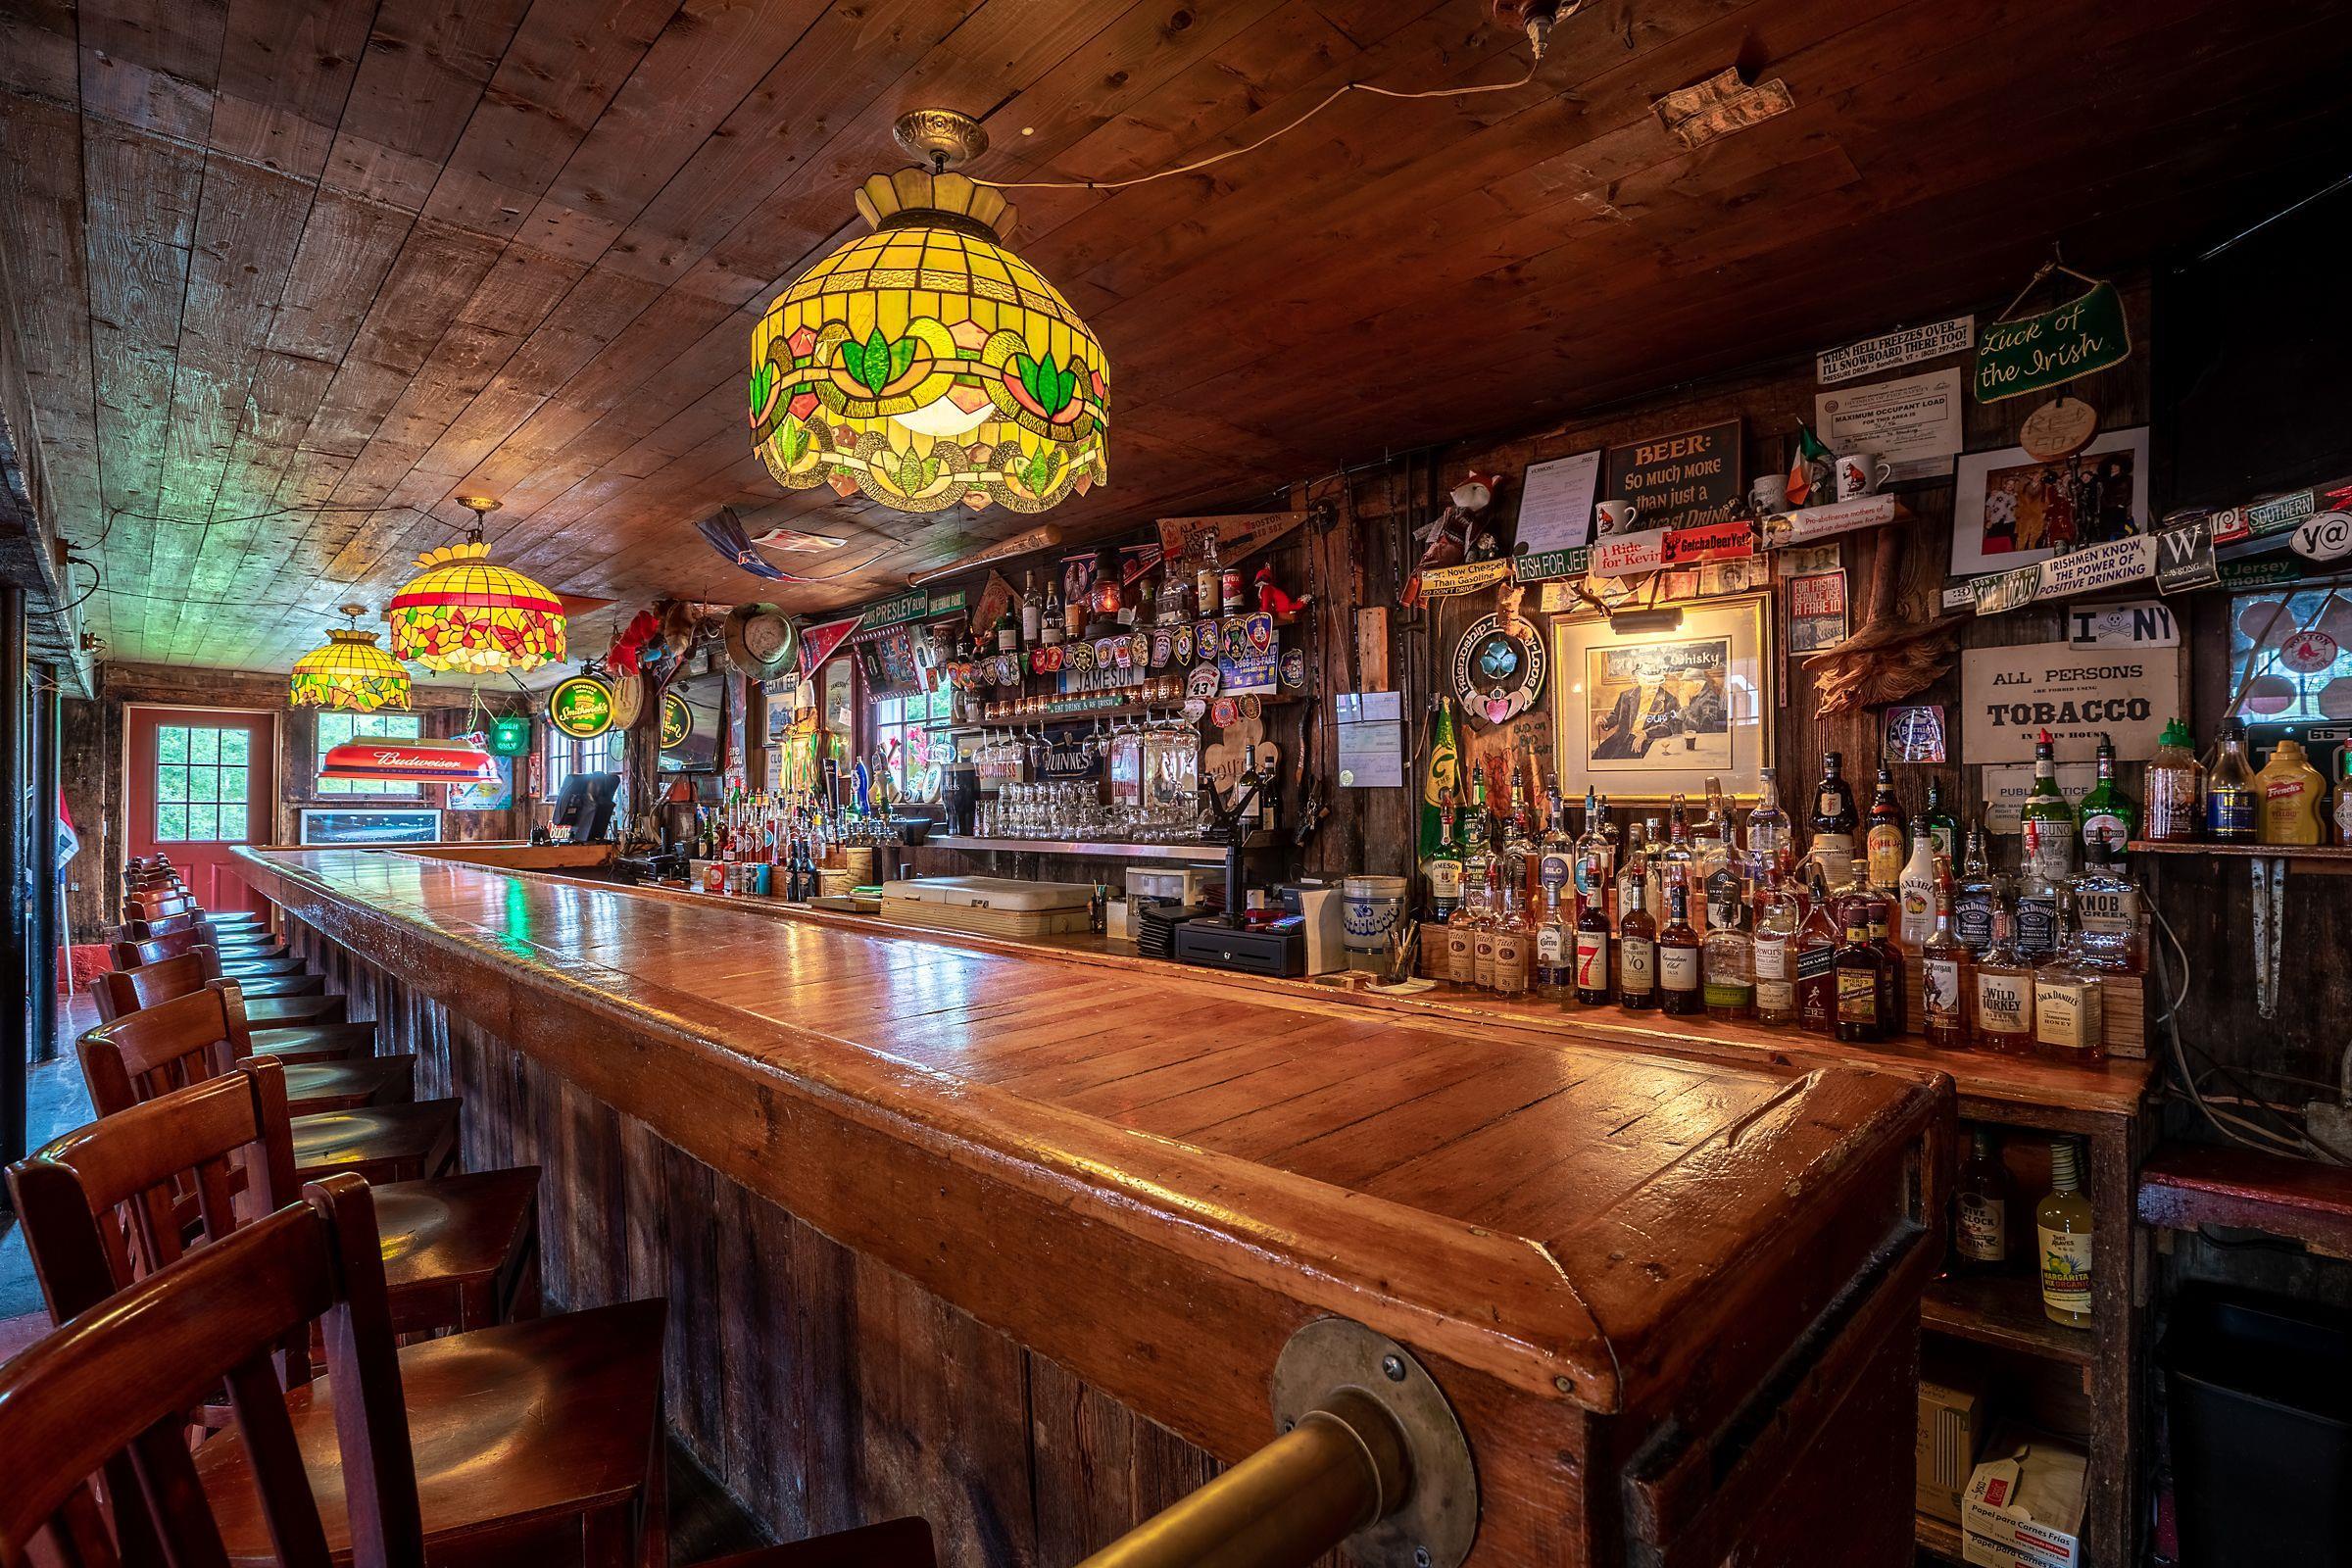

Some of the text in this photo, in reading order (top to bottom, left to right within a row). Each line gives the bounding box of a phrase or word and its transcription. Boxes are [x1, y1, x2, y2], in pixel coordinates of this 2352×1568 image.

[1981, 304, 2085, 356] Luck of
[1823, 329, 1923, 364] WHEN HELL FREEZES
[1823, 329, 1967, 375] I'LL SNOWBOARD THERE TOO!
[1823, 370, 1851, 382] PRESSURE
[1852, 366, 1870, 375] DROP
[1921, 348, 1937, 359] (802)
[1980, 331, 2104, 388] the Irish
[1835, 398, 1945, 423] MAXIMUM OCCUPANT LOAD
[1635, 434, 1712, 466] BEER:
[1531, 465, 1554, 474] VERMONT
[1850, 507, 1875, 518] mothers
[1876, 505, 1884, 514] of
[2250, 497, 2312, 526] SOUTHERN
[1251, 514, 1282, 529] BOSTON
[1269, 524, 1284, 535] SOX
[1612, 541, 1642, 556] Ride
[2163, 524, 2202, 564] W
[1602, 551, 1661, 568] for Kevin
[2049, 540, 2141, 572] IRISHMEN KNOW
[1447, 566, 1467, 577] Now
[1469, 560, 1506, 575] Cheaper
[1520, 552, 1565, 577] FISH FOR
[2056, 554, 2134, 581] THE POWER OF
[2234, 560, 2289, 575] Jersey
[1433, 571, 1494, 588] Than Gasoline
[1794, 577, 1840, 593] FOR FASTER
[1974, 567, 2036, 587] DON'T PISS OFF
[2039, 578, 2084, 596] POSITIVE
[2087, 564, 2145, 586] DRINKING
[2215, 572, 2275, 588] ermont
[1433, 587, 1455, 596] DON'T
[1794, 589, 1840, 604] SERVICE USE
[1978, 584, 1997, 612] THE
[2002, 576, 2036, 610] LOCALS
[876, 597, 912, 624] PRESLEY
[912, 597, 926, 611] BLVD
[1794, 601, 1829, 615] A FAKE
[2073, 608, 2171, 643] I NY
[1077, 665, 1135, 692] JAMESON
[1992, 664, 2143, 685] ALL PERSONS
[1193, 683, 1208, 695] 43
[560, 702, 609, 721] Smithwick's
[1054, 699, 1113, 713] EAT DRINK IRISH
[1986, 697, 2151, 727] TOBACCO
[373, 752, 462, 768] Budweiser
[1044, 750, 1095, 772] GUINNESS
[1436, 775, 1450, 786] THE
[2267, 782, 2304, 799] French's
[1434, 862, 1459, 871] JAMESON
[1955, 904, 1970, 914] JACK
[2030, 904, 2055, 917] DANIEL'S
[2077, 896, 2120, 911] KNOB
[2126, 919, 2132, 930] 9
[1449, 932, 1467, 941] Tito's
[1476, 934, 1494, 943] Tito's
[1496, 939, 1517, 948] Tito's
[1540, 938, 1557, 947] Cuervo
[1756, 946, 1782, 956] Dewar's
[1579, 946, 1599, 986] 7
[1798, 959, 1813, 968] BLACK
[1814, 956, 1831, 964] LABEL
[1931, 962, 1952, 974] Morgan
[1985, 988, 2015, 1001] WILD
[2037, 991, 2080, 1006] JACK DANIEL'S
[1982, 996, 2021, 1011] TURKEY
[2043, 1012, 2071, 1021] Tennessee
[2052, 1239, 2074, 1248] AGAVES
[2043, 1272, 2089, 1282] MARGARITA
[1972, 1504, 2046, 1538] Papel para Carnes
[1972, 1535, 1995, 1549] Papel
[1995, 1544, 2016, 1557] para
[2018, 1551, 2046, 1568] Carnes
